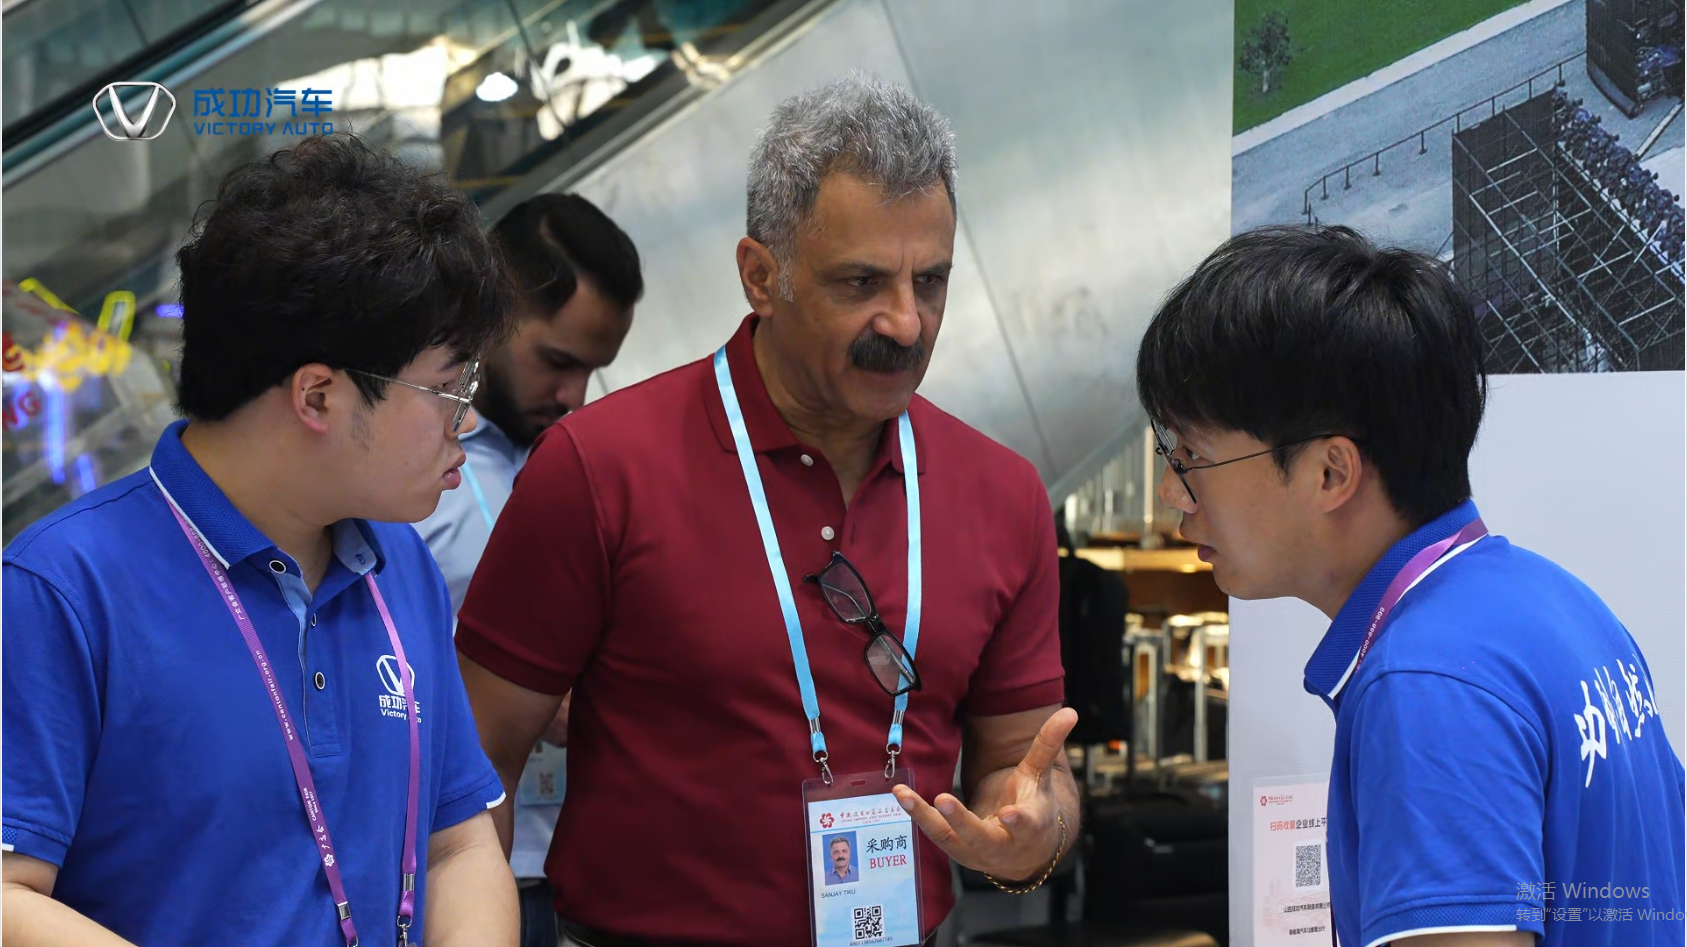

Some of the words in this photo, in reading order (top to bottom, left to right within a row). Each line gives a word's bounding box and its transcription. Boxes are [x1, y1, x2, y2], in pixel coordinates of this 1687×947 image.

[865, 834, 908, 853] 采购商
[869, 854, 908, 869] BUYER
[821, 890, 842, 899] SANJAY
